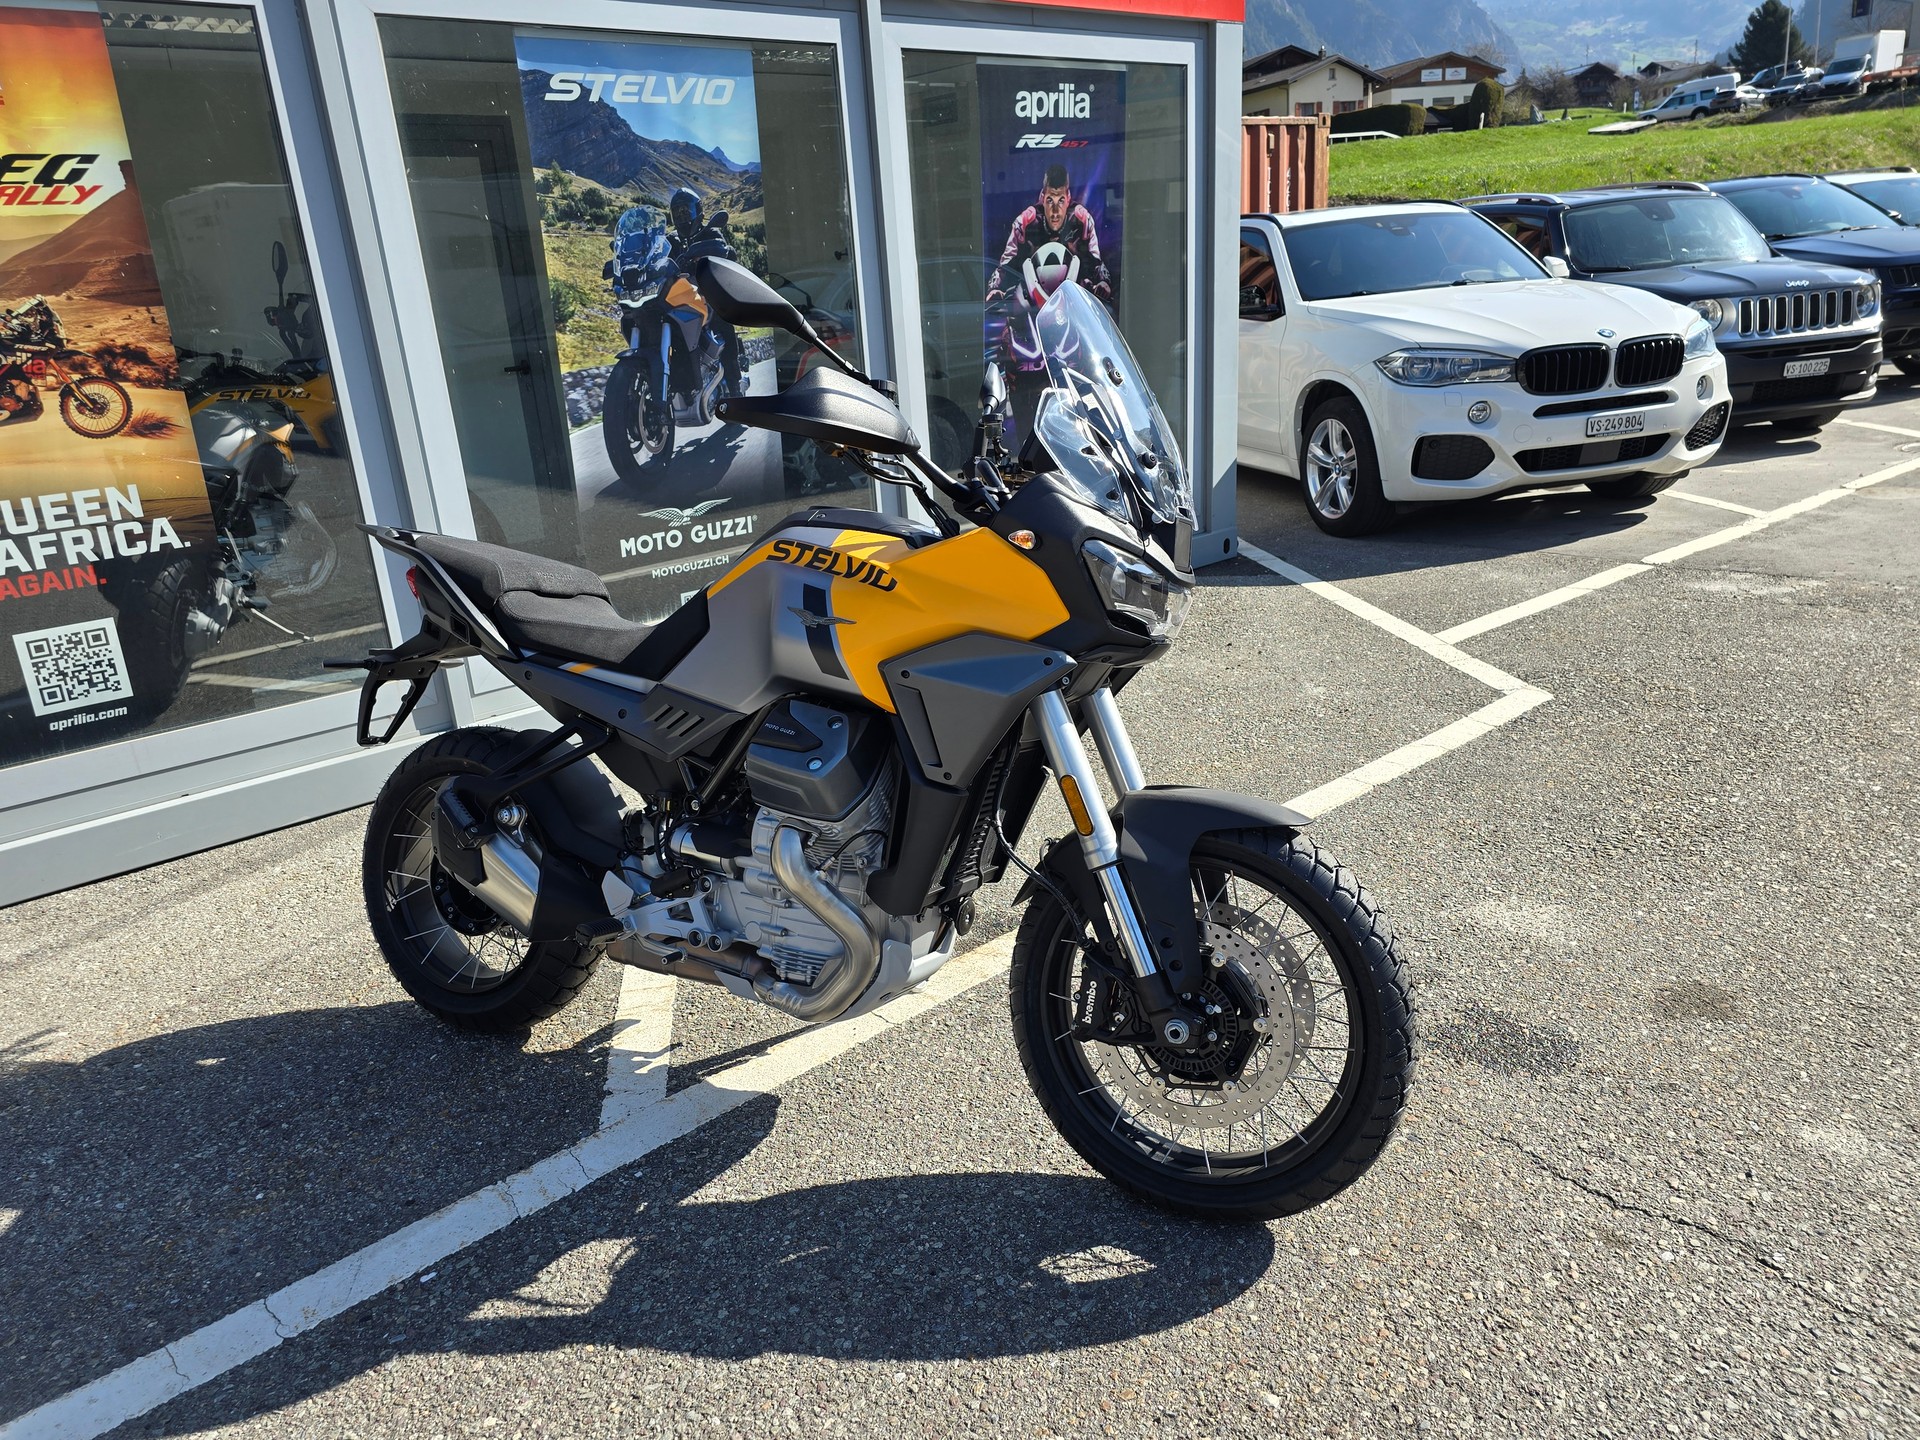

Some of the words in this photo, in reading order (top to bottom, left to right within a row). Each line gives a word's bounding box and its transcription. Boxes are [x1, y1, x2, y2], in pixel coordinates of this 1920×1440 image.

[544, 72, 735, 105] STELVIO
[1015, 83, 1090, 124] aprilia
[1785, 280, 1810, 288] Jeep
[216, 388, 312, 402] STELVIO
[0, 484, 144, 535] UEEN
[0, 517, 191, 575] AFRICA.
[620, 529, 683, 558] MOTO
[690, 515, 753, 543] GUZZI
[0, 565, 107, 600] AGAIN.
[652, 555, 730, 579] MOTOGUZZI.CH
[766, 540, 898, 592] STELVIO
[49, 706, 128, 731] aprilia.com
[765, 723, 779, 731] MOTO
[780, 727, 796, 736] GUZZI
[1082, 981, 1097, 1024] brembo
